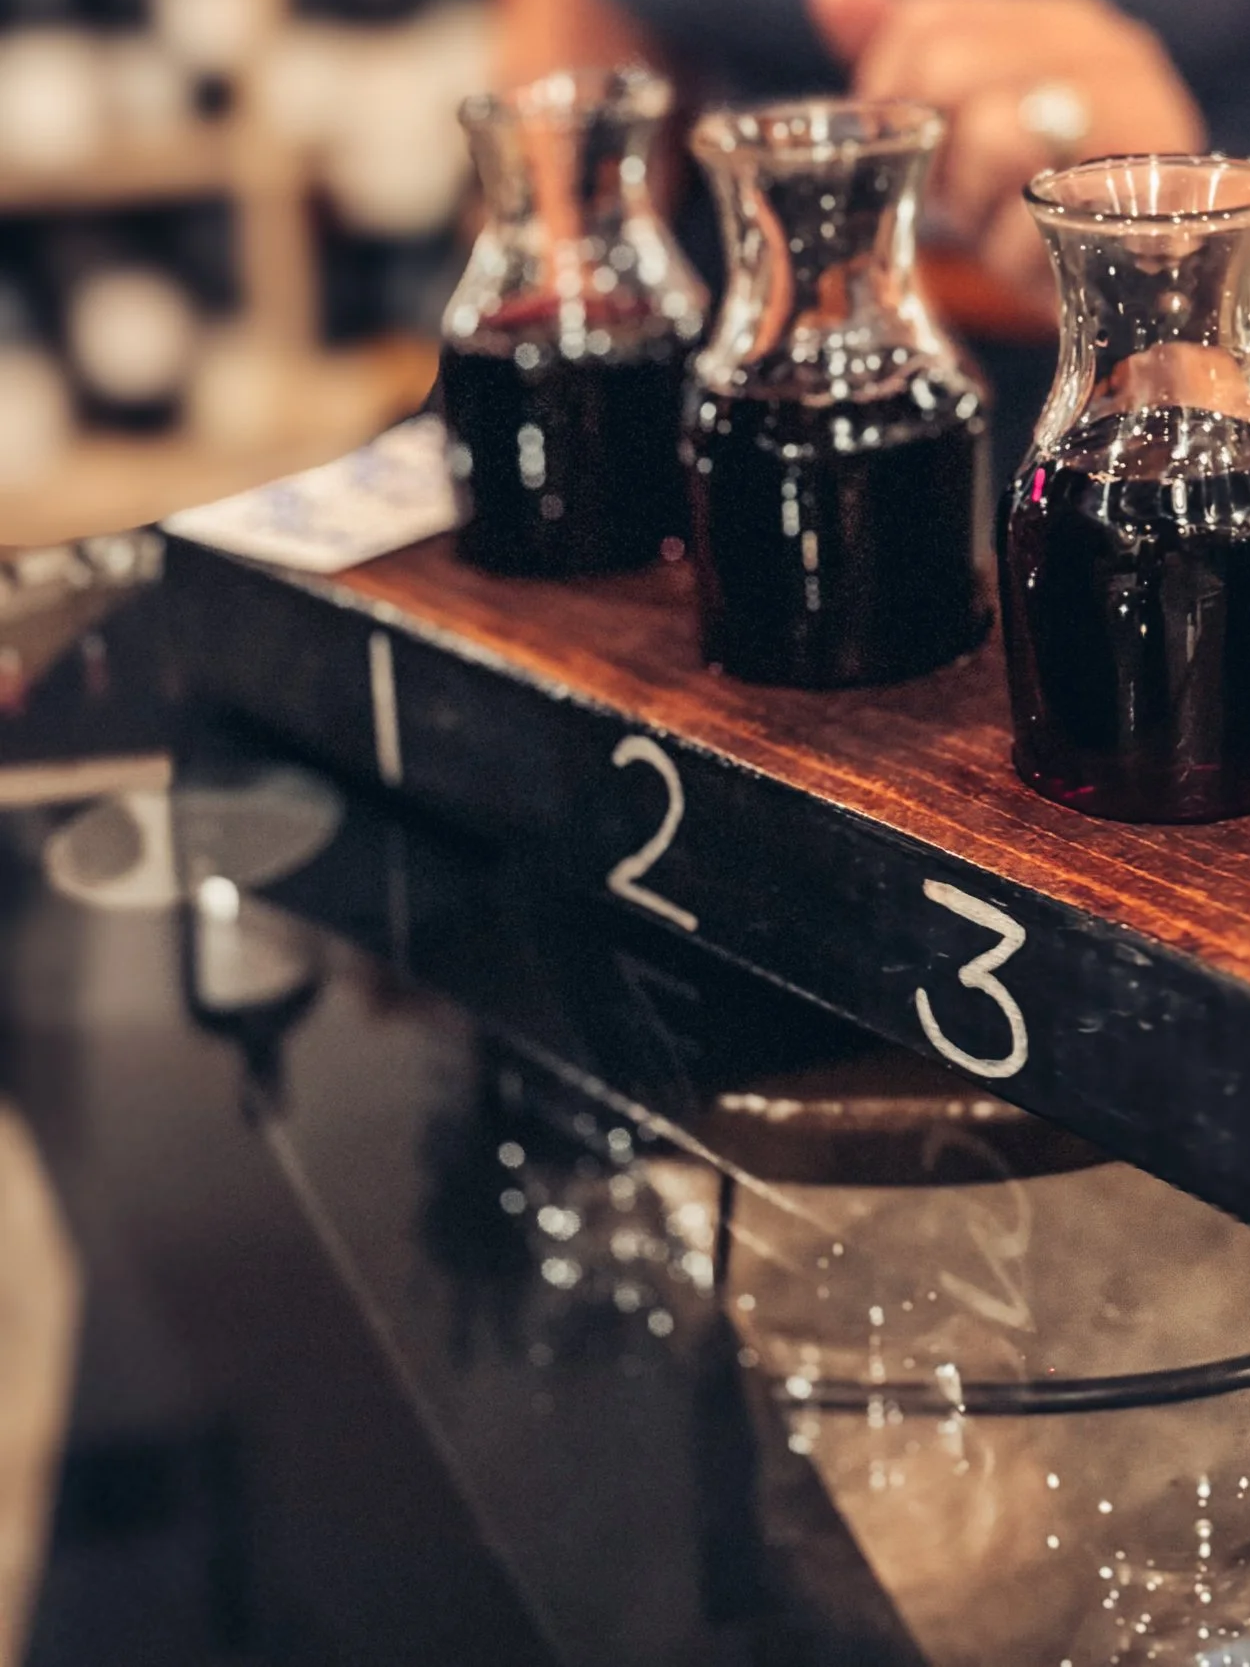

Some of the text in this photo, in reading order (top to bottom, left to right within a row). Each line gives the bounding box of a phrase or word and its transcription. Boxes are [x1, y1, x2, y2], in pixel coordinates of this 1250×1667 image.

[368, 631, 402, 787] 1
[607, 735, 699, 933] 2
[915, 878, 1029, 1079] 3
